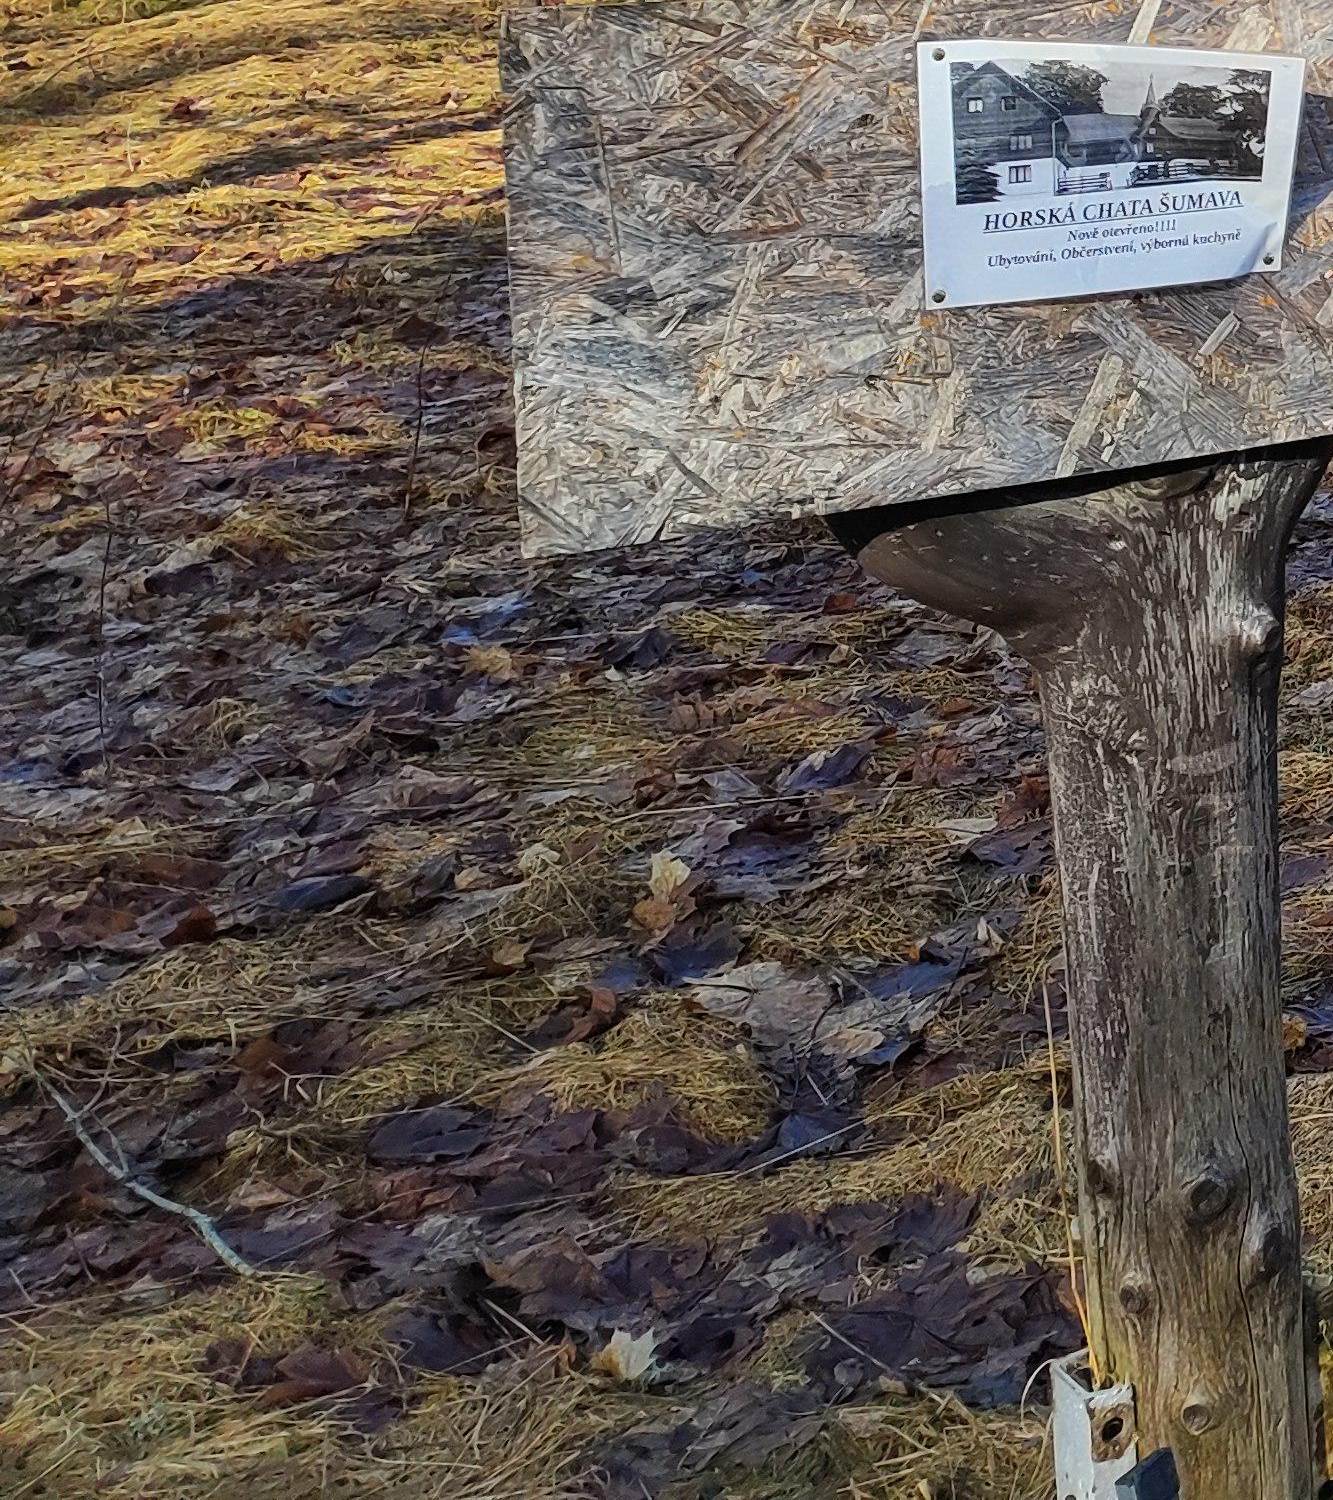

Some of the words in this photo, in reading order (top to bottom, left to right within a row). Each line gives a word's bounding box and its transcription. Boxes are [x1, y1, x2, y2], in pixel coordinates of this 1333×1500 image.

[983, 201, 1077, 231] HORSKÁ
[1083, 199, 1153, 221] CHATA
[1158, 190, 1243, 213] ŠUMAVA
